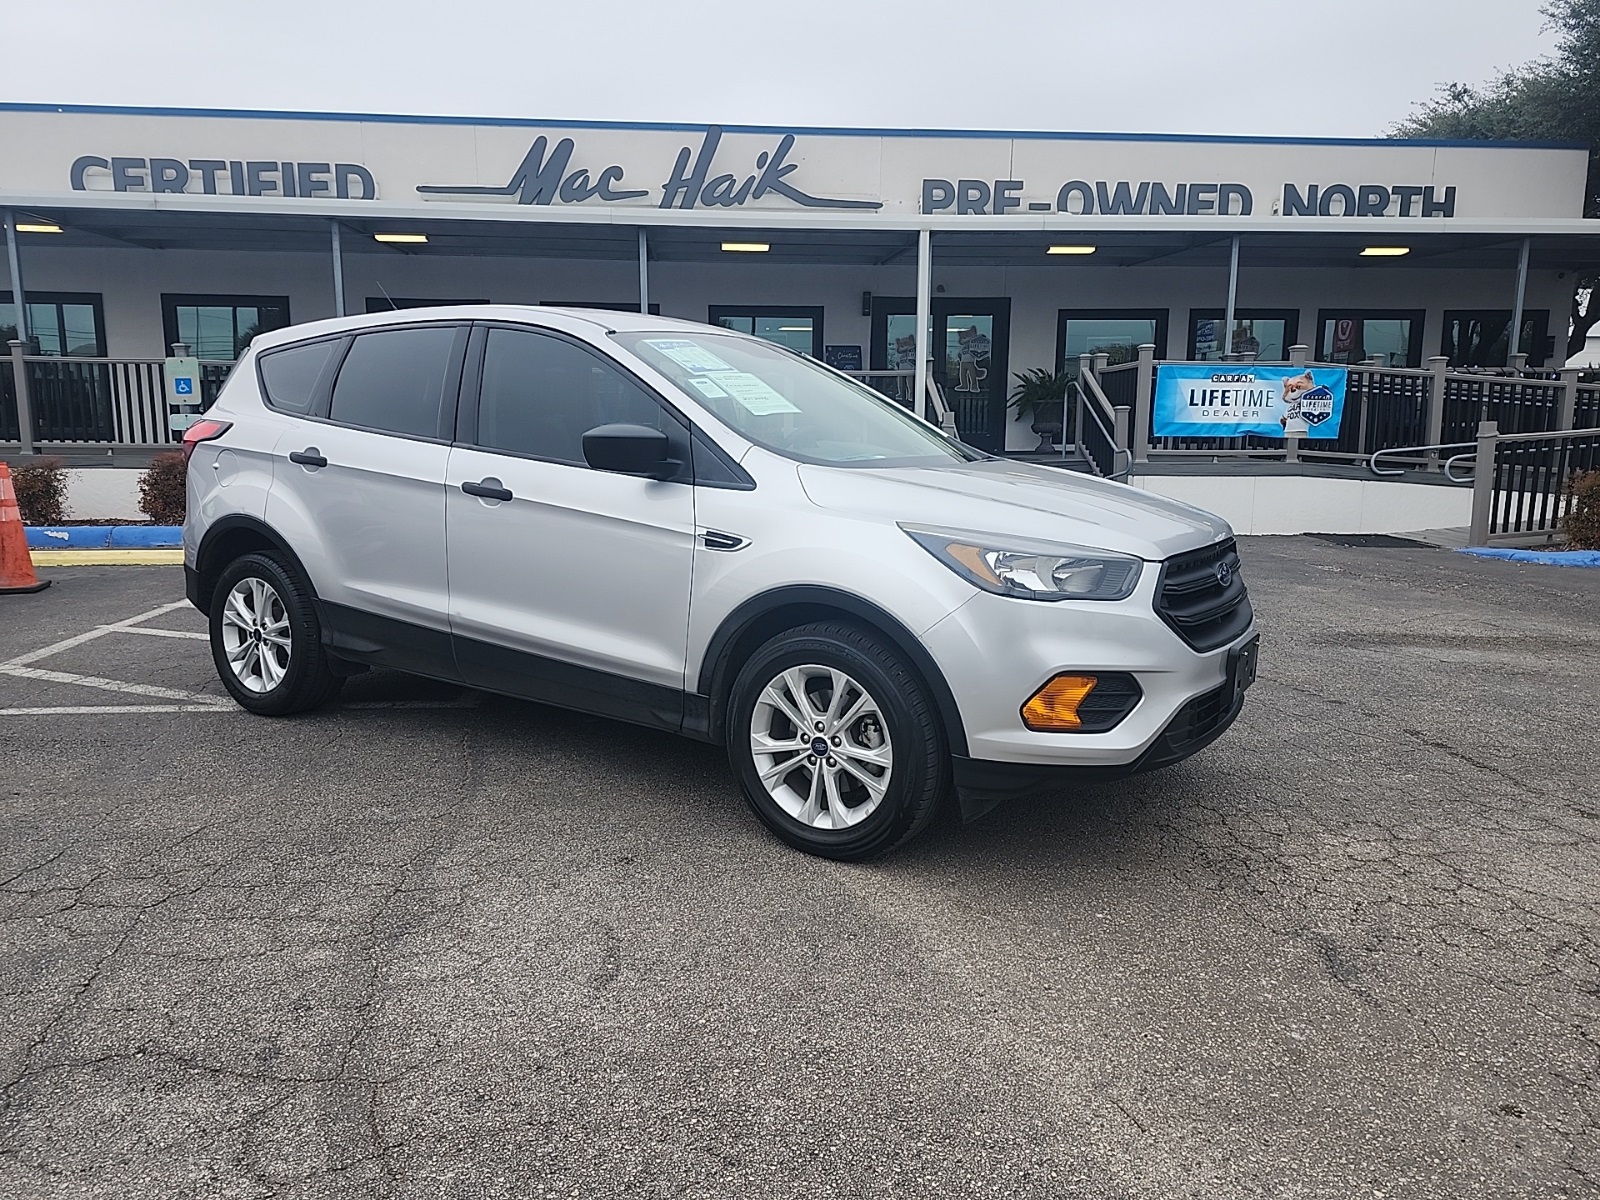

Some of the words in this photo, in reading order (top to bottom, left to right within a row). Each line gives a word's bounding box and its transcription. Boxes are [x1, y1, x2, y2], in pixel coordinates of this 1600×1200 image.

[70, 155, 376, 200] CERTIFIED
[416, 135, 649, 206] Mac
[659, 125, 884, 210] Haik
[922, 179, 1254, 216] PRE-OWNED
[1283, 183, 1457, 217] NORTH
[1212, 375, 1255, 383] CARFAX
[1188, 388, 1275, 408] LIFETIME
[1302, 400, 1332, 409] LIFETIME
[1202, 409, 1259, 418] DEALER
